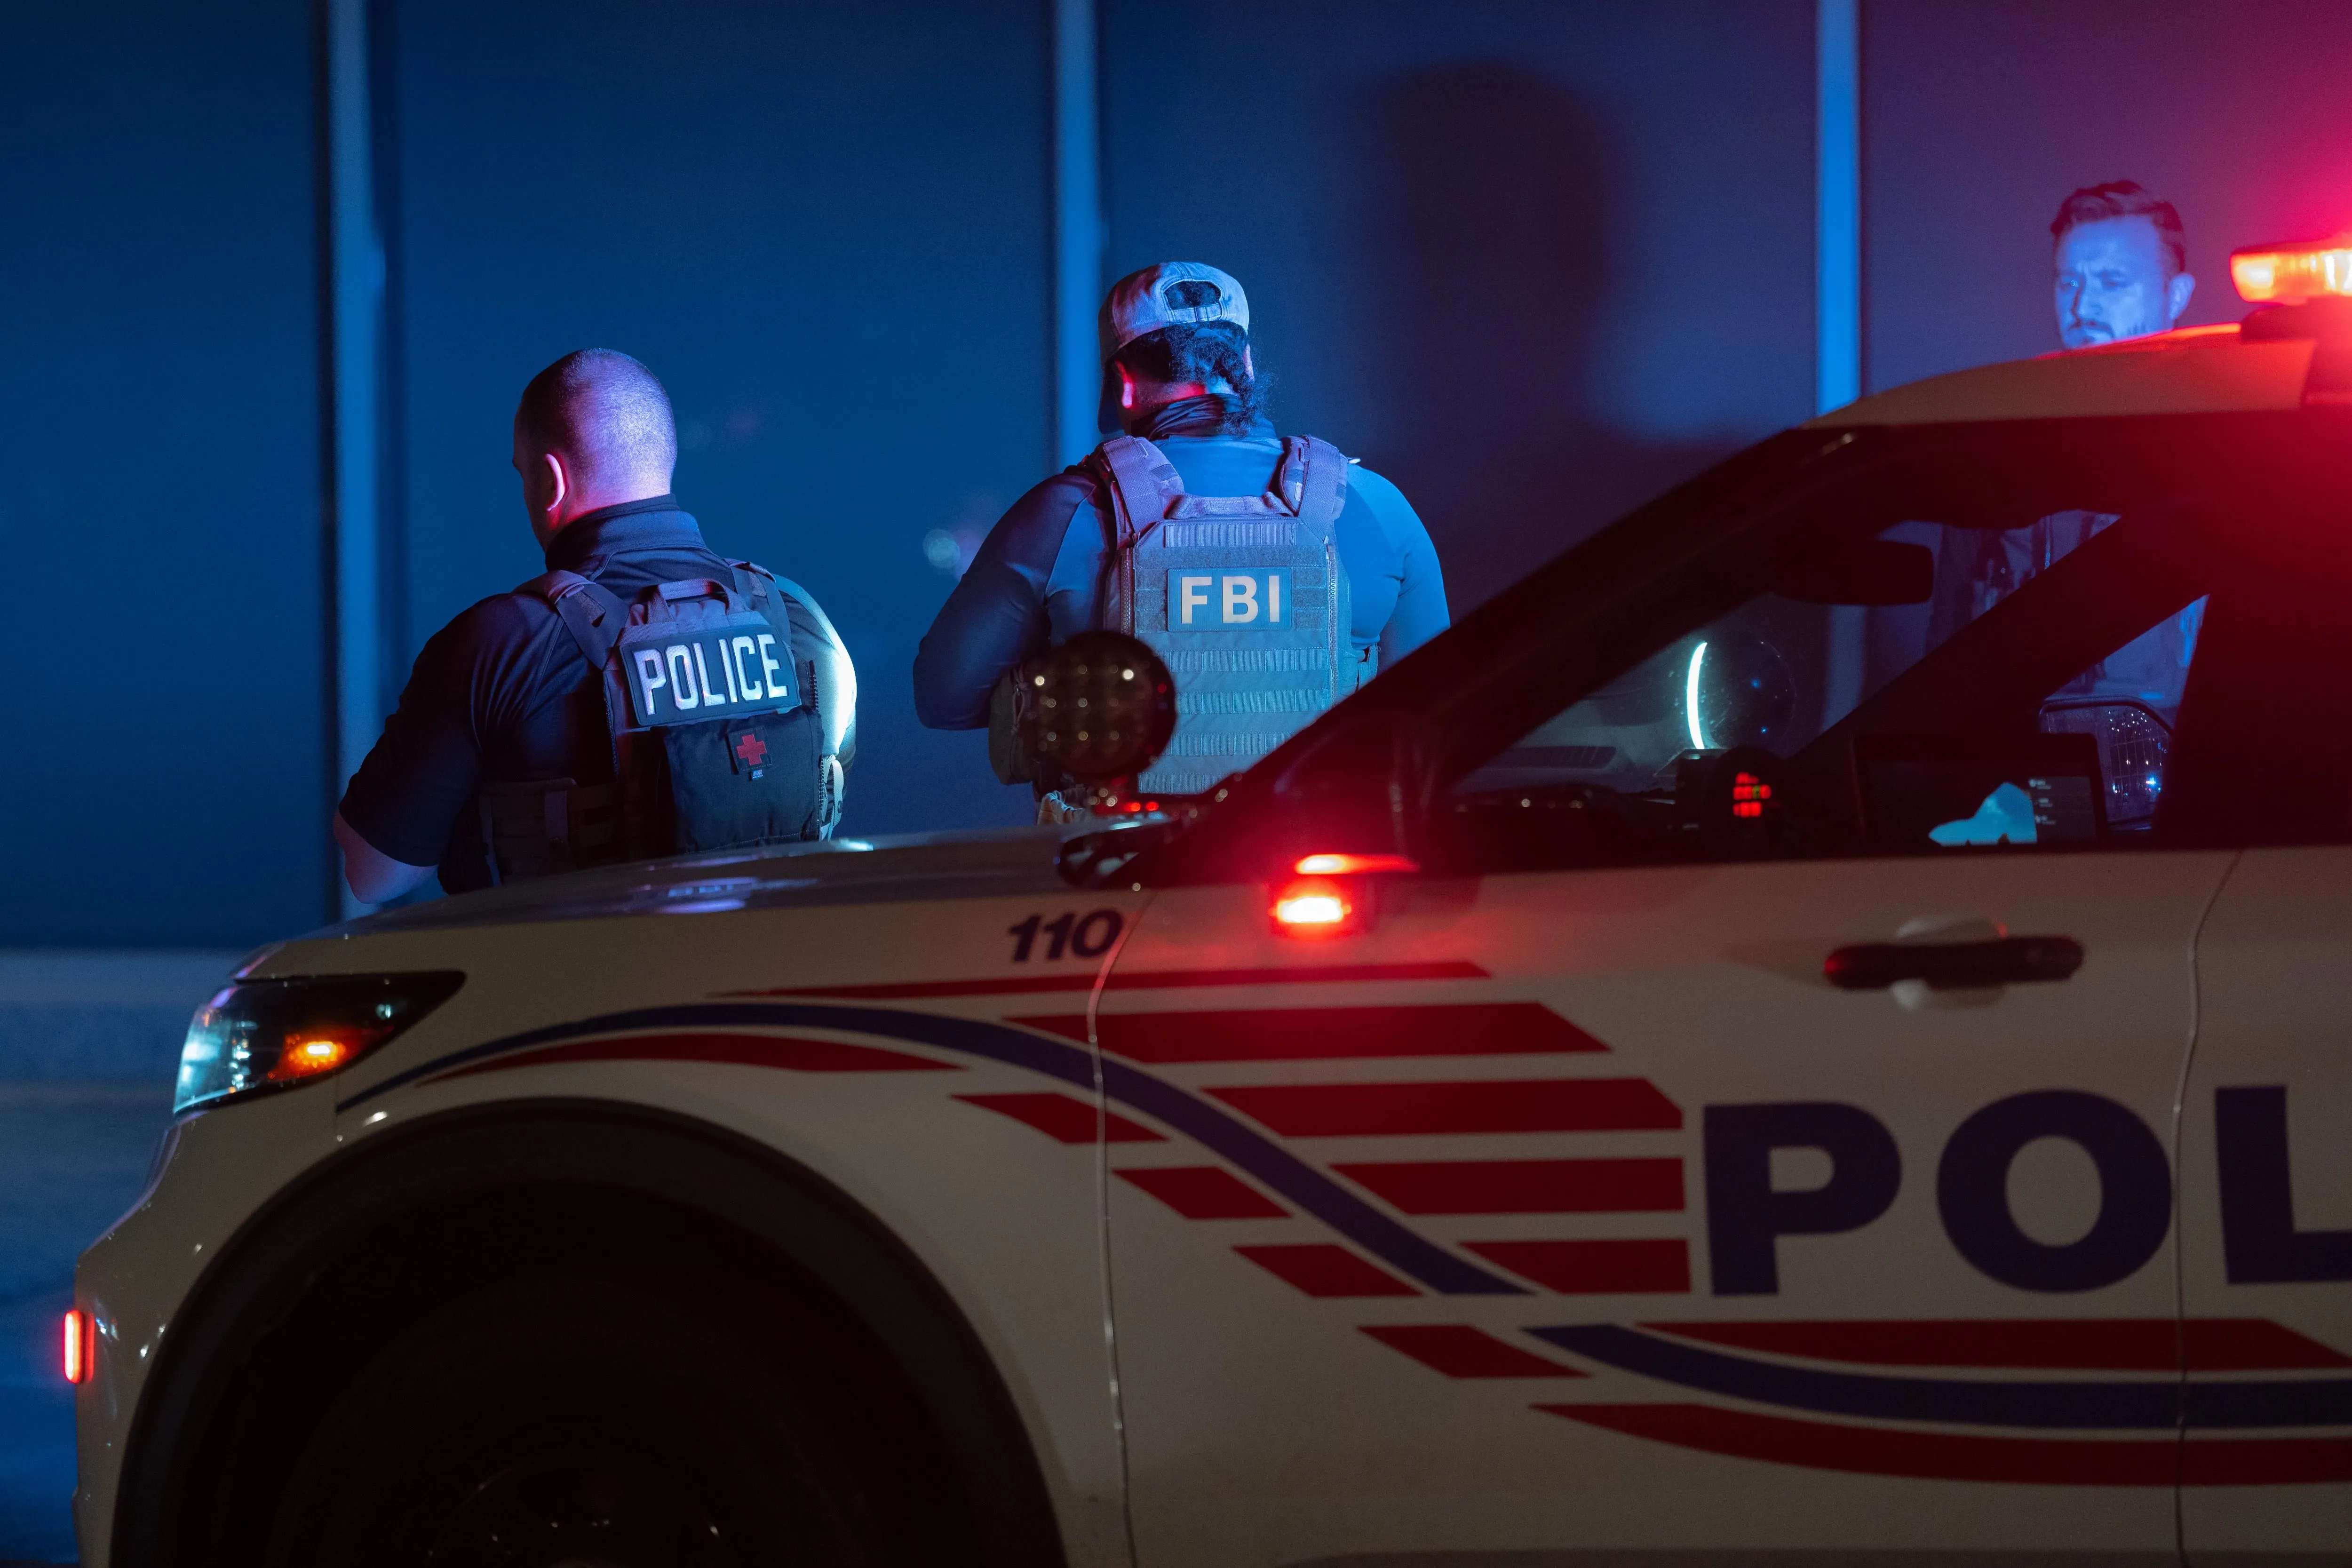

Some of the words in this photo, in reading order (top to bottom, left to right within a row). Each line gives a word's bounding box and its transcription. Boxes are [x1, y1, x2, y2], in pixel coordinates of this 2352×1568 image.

[1181, 575, 1280, 624] FBI
[633, 633, 789, 716] POLICE
[1009, 909, 1124, 962] 110
[1703, 1085, 2352, 1297] POL
